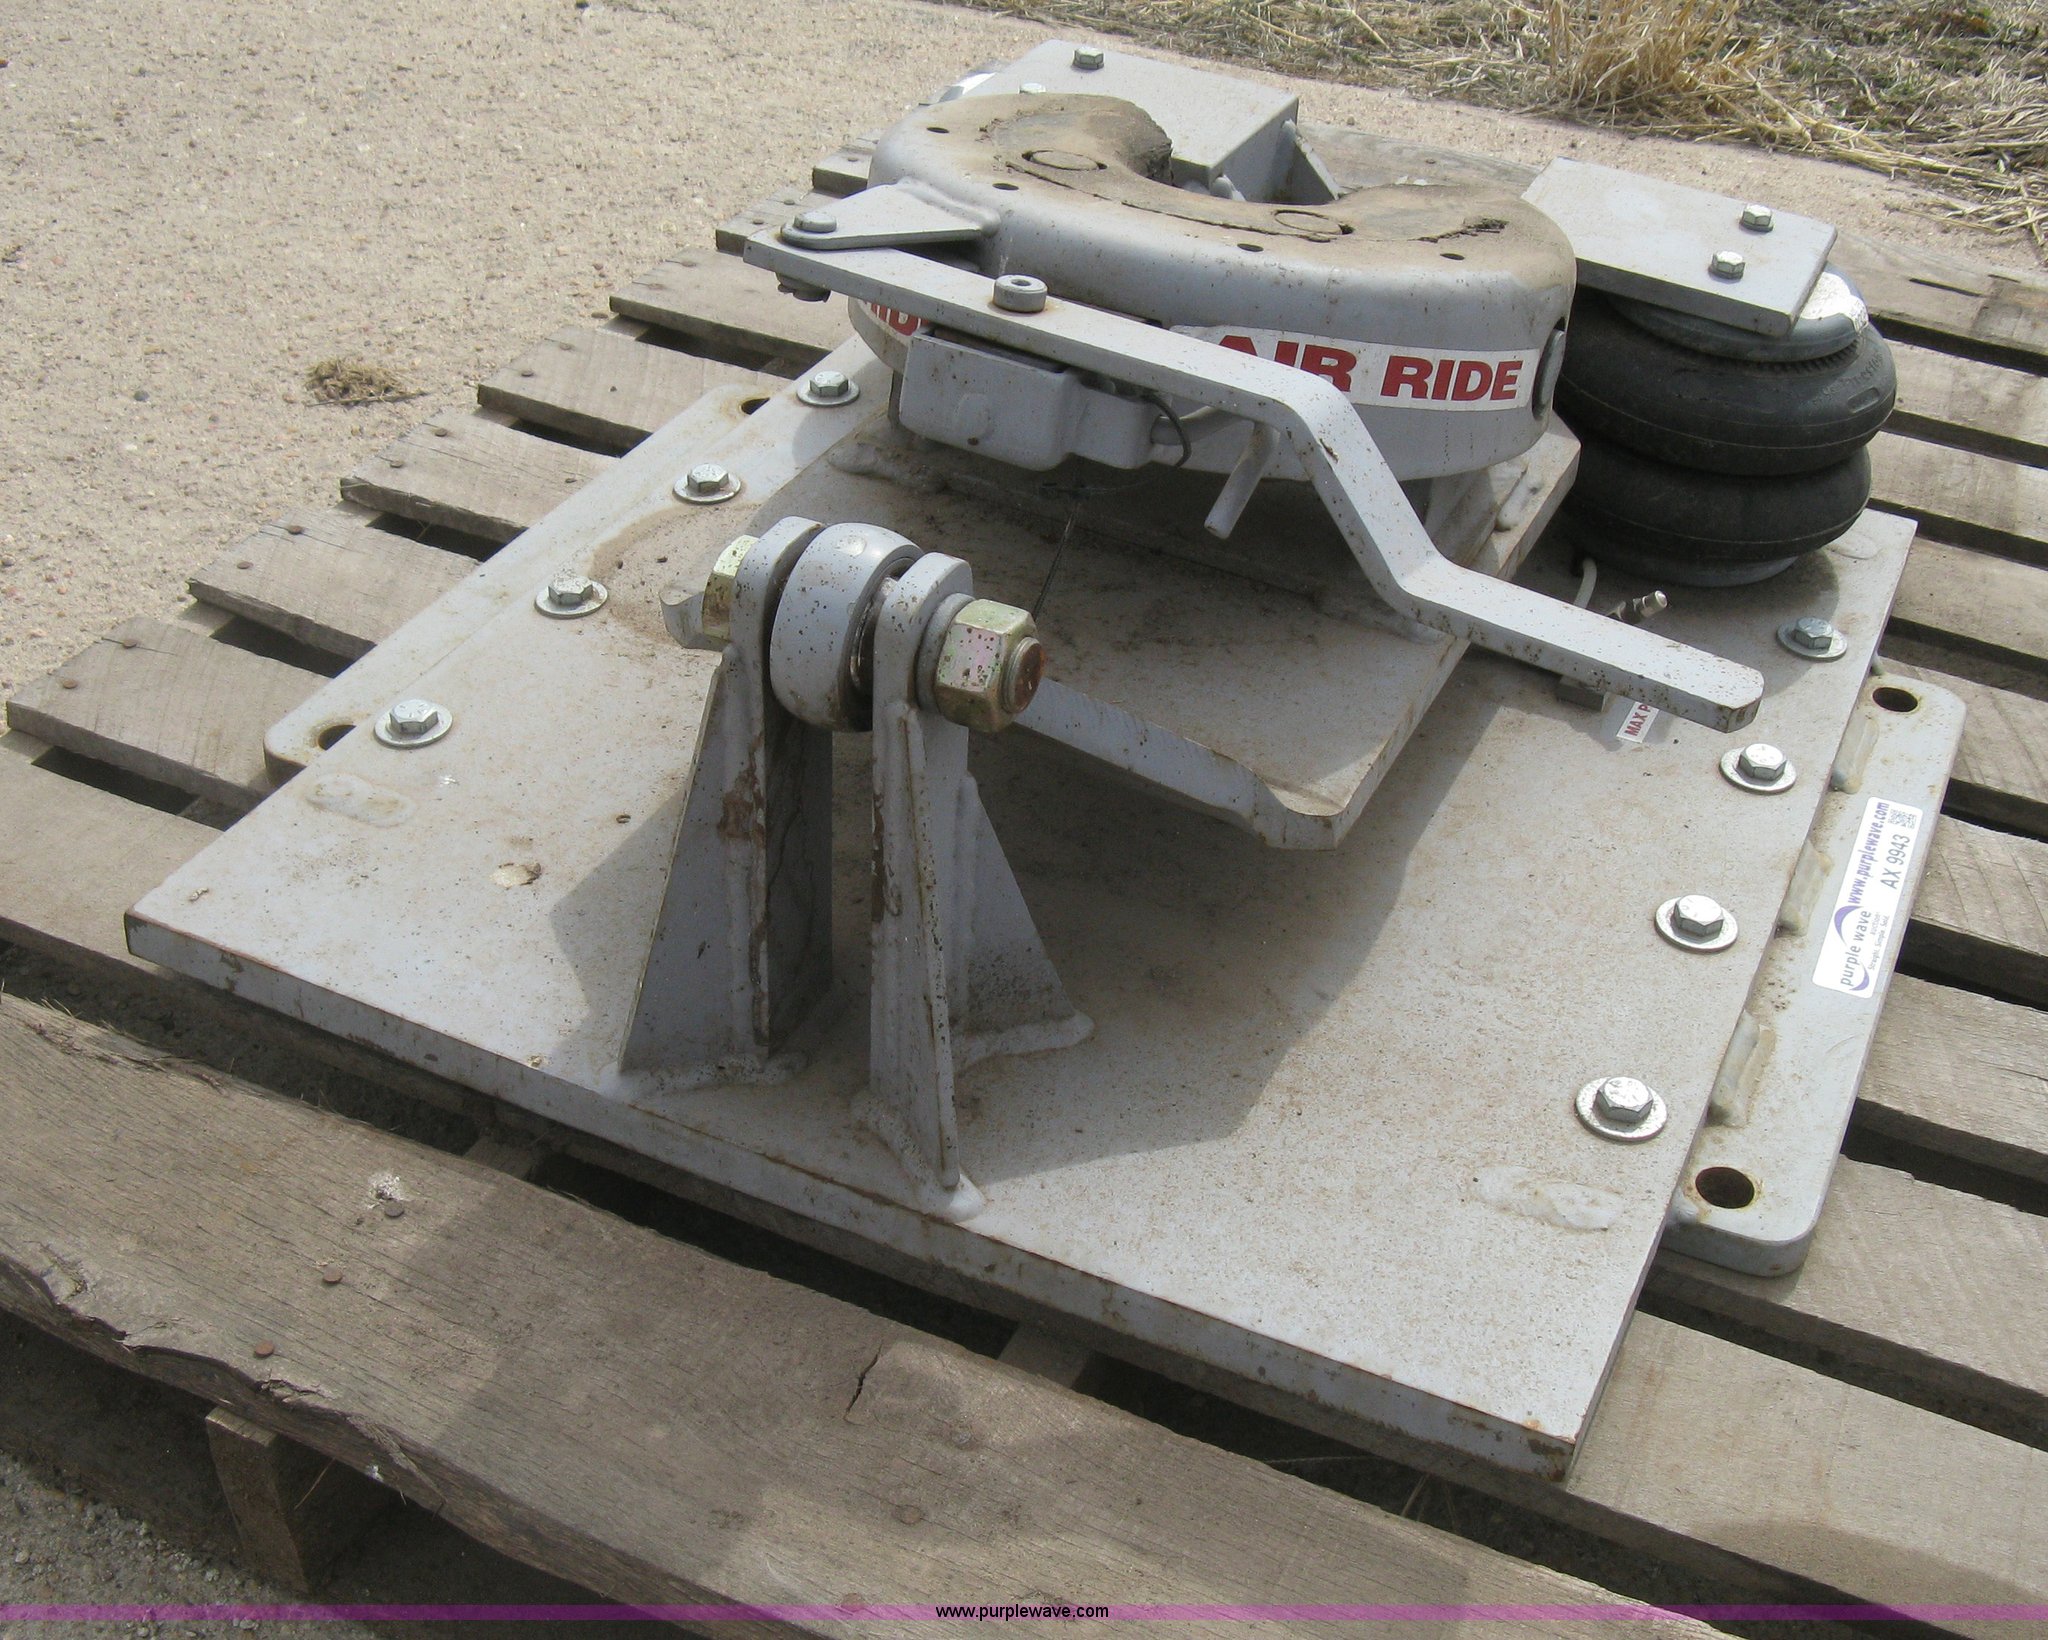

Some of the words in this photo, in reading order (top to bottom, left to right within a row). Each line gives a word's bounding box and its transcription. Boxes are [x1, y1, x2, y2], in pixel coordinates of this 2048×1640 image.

[1380, 355, 1523, 401] RIDE
[1624, 711, 1648, 737] MAX
[1847, 802, 1890, 905] www.purplewave.com
[1886, 834, 1911, 866] 9943
[1880, 867, 1902, 890] AX
[1840, 945, 1863, 987] purple
[1853, 910, 1873, 942] wave
